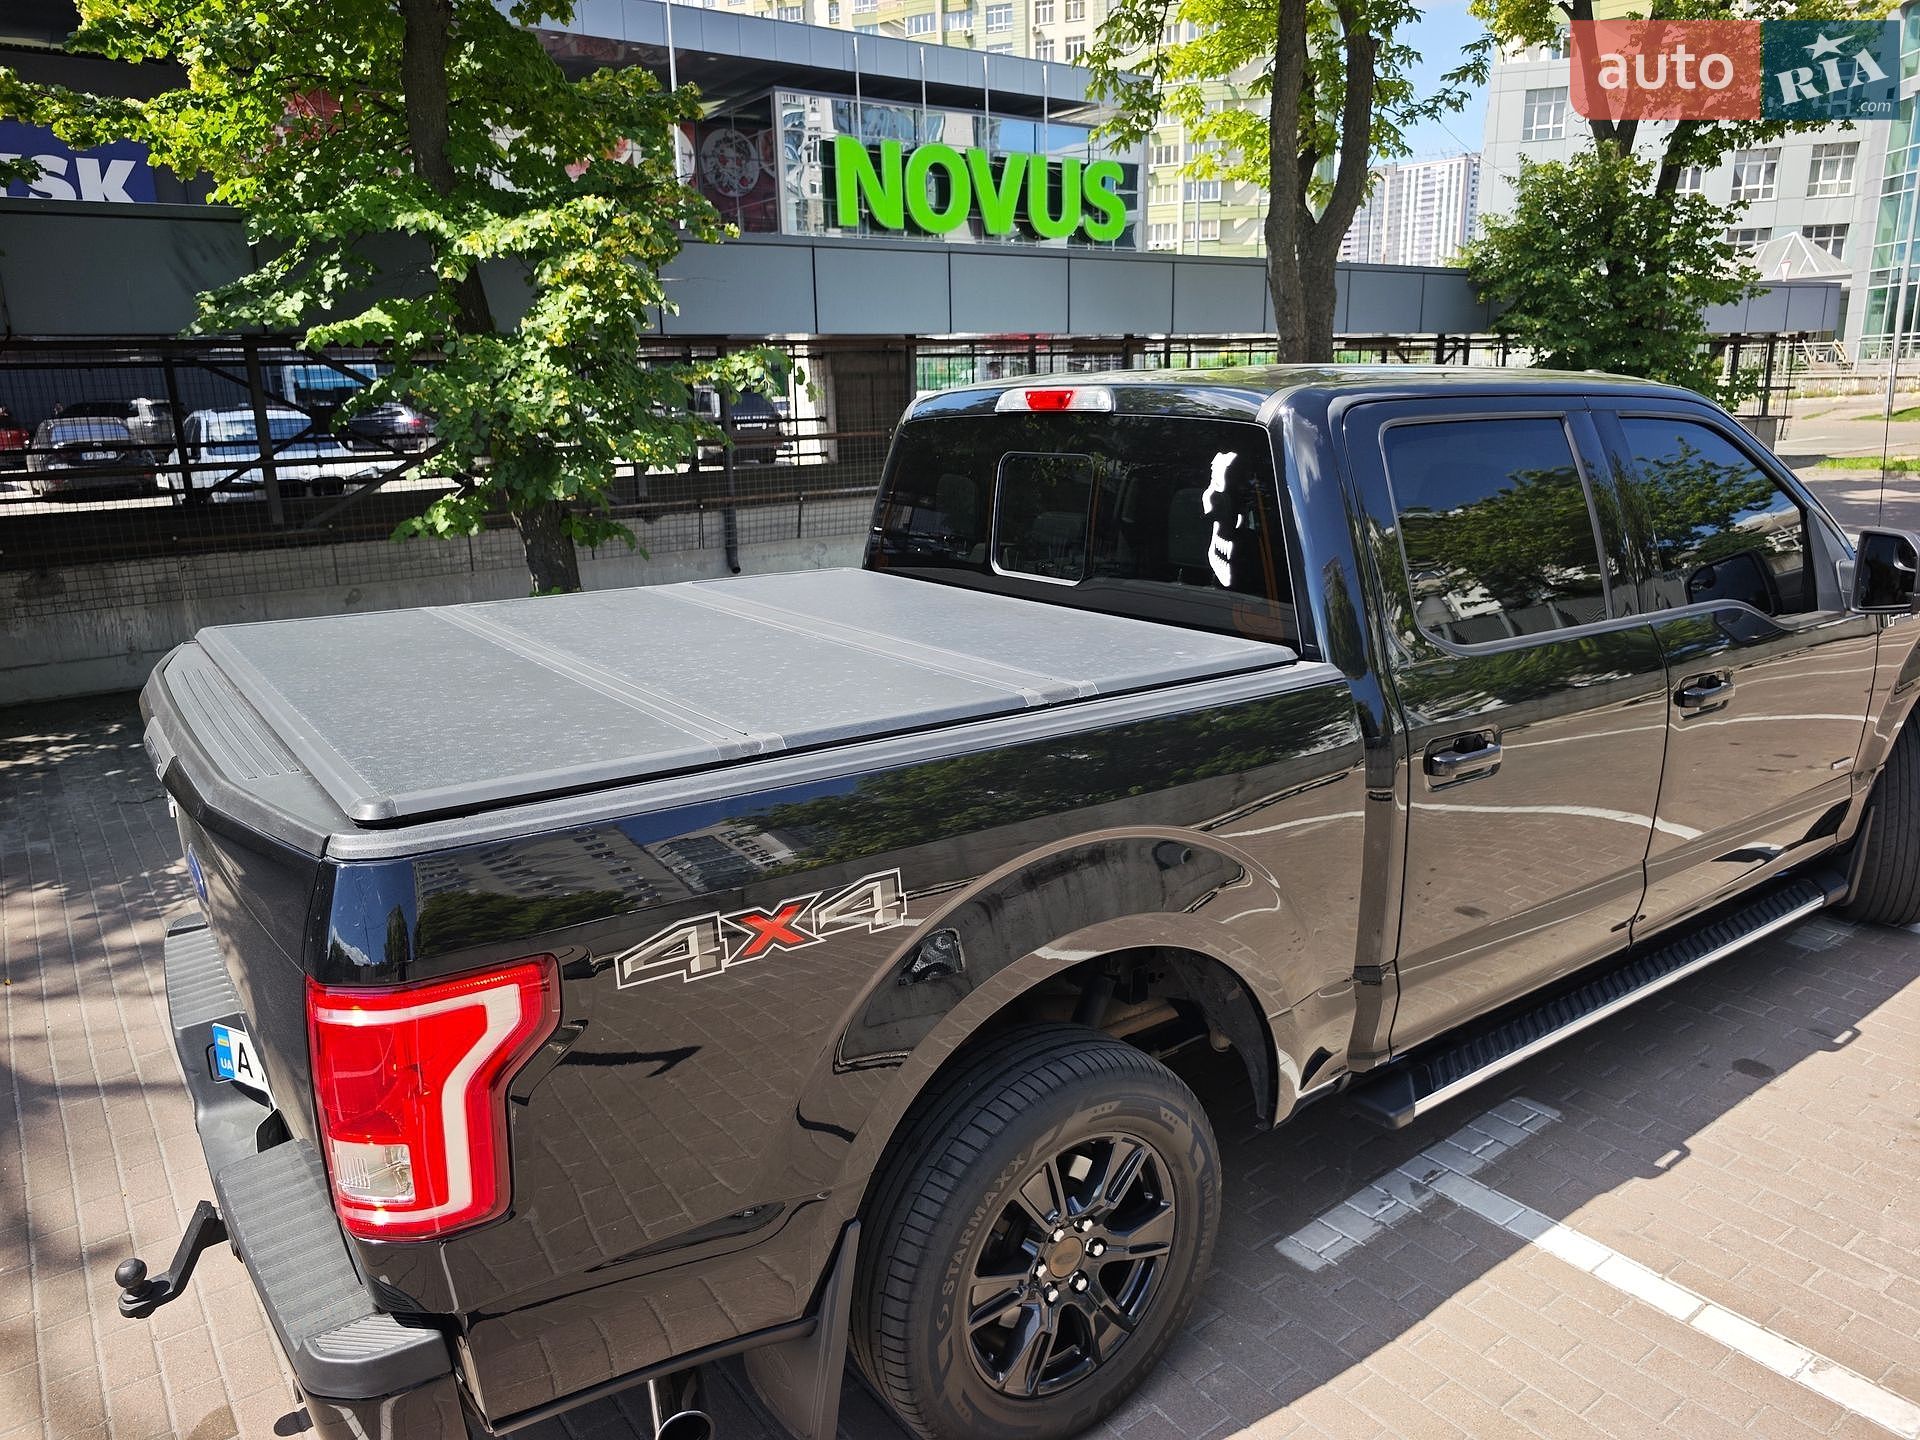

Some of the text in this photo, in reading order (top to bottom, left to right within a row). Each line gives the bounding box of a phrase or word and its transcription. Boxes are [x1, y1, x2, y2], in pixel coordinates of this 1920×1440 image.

[0, 153, 136, 203] SK
[835, 135, 1127, 241] NOVUS
[220, 1057, 234, 1071] UA
[943, 1156, 1026, 1296] STARMAXX
